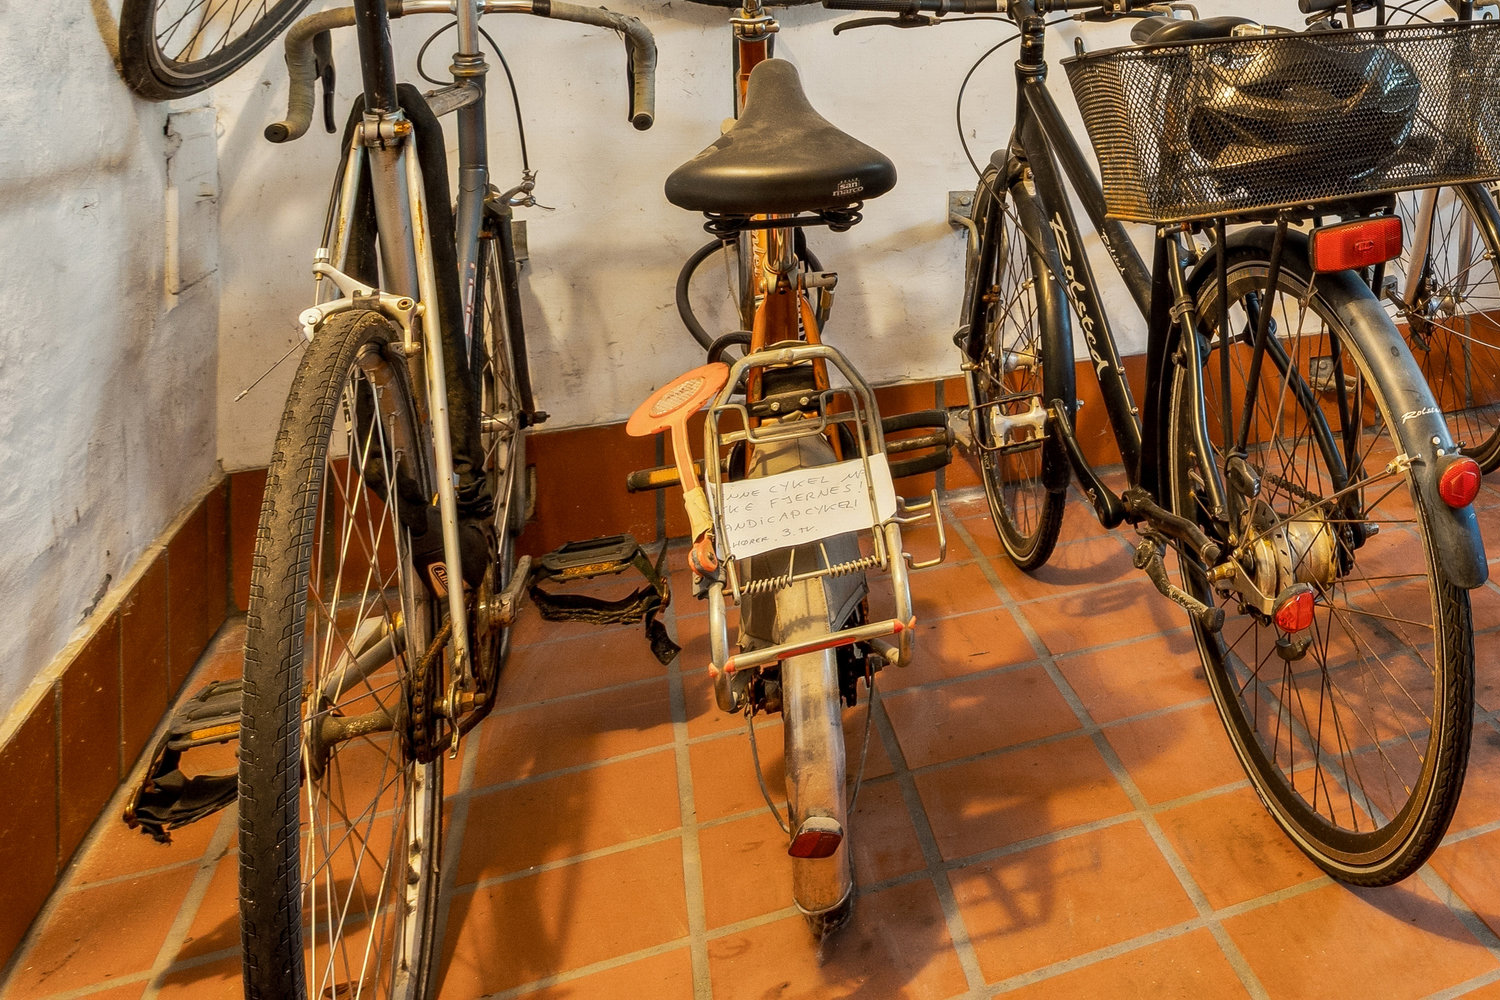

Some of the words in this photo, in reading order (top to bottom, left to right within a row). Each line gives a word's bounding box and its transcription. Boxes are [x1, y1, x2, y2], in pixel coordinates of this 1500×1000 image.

[840, 181, 858, 190] san
[832, 186, 864, 197] marco
[769, 476, 829, 493] CYKEL
